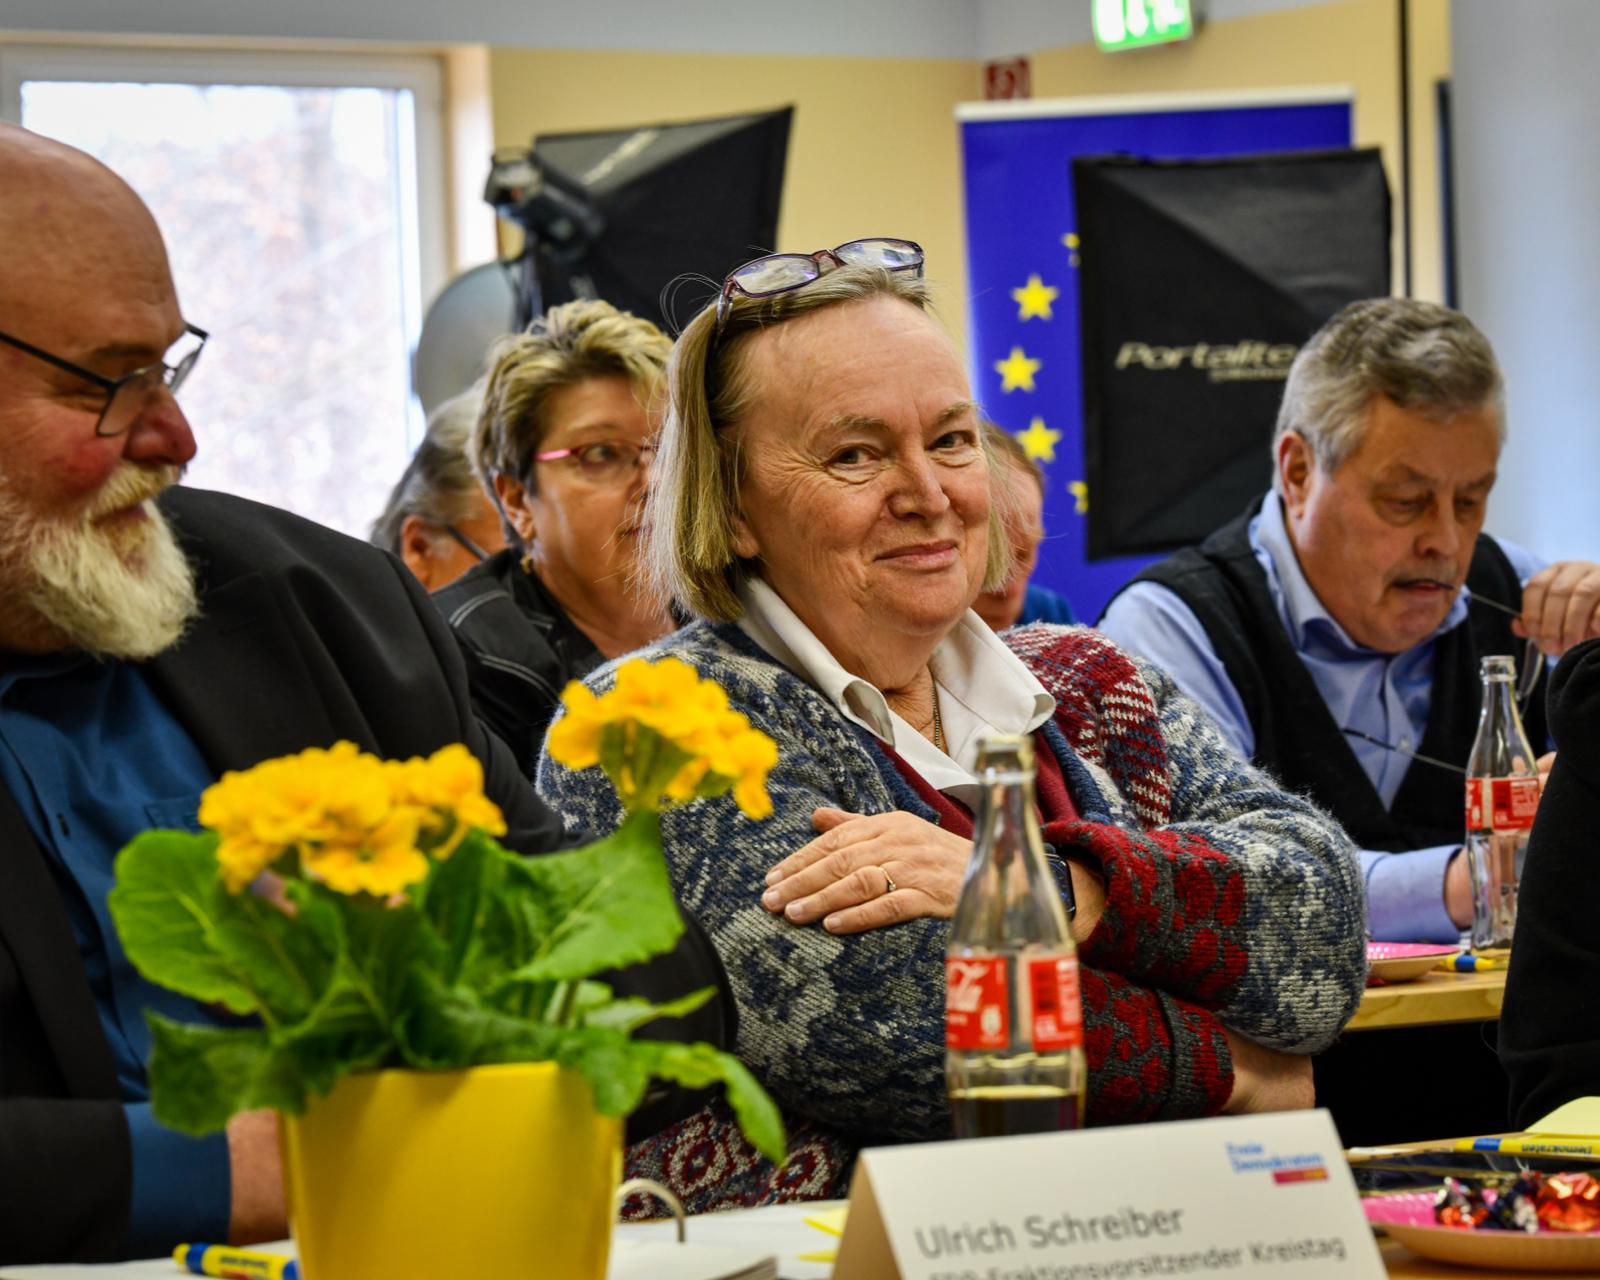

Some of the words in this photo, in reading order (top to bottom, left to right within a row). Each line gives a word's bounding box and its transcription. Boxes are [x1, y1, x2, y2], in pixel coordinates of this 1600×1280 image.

[914, 1218, 1017, 1260] Ulrich
[1023, 1206, 1184, 1249] Schreiber
[1249, 1237, 1347, 1263] Kreistag
